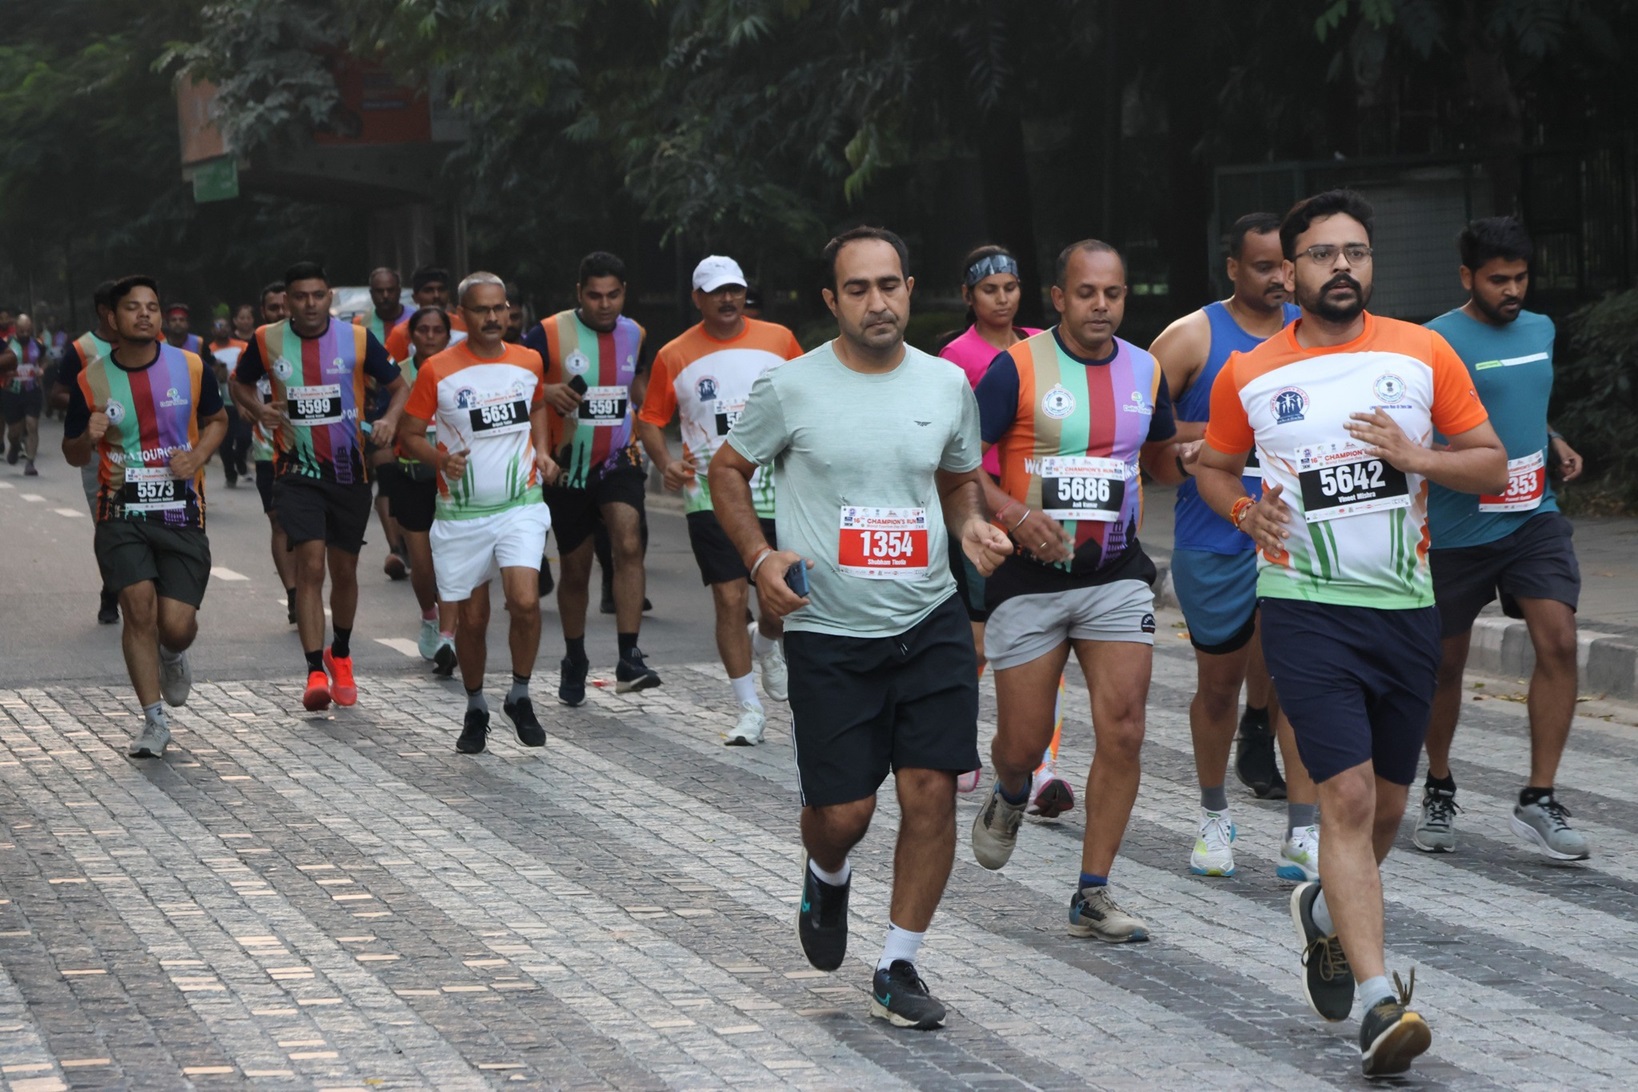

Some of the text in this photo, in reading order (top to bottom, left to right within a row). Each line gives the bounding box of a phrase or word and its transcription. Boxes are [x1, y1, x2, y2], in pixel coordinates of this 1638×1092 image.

[297, 398, 331, 415] 5599
[481, 402, 517, 424] 5631
[589, 399, 619, 415] 5591
[1324, 448, 1366, 461] CHAMPION'
[137, 480, 174, 498] 5573
[1057, 477, 1110, 502] 5686
[1319, 460, 1386, 497] 5642
[1500, 471, 1538, 496] 353
[860, 530, 913, 558] 1354
